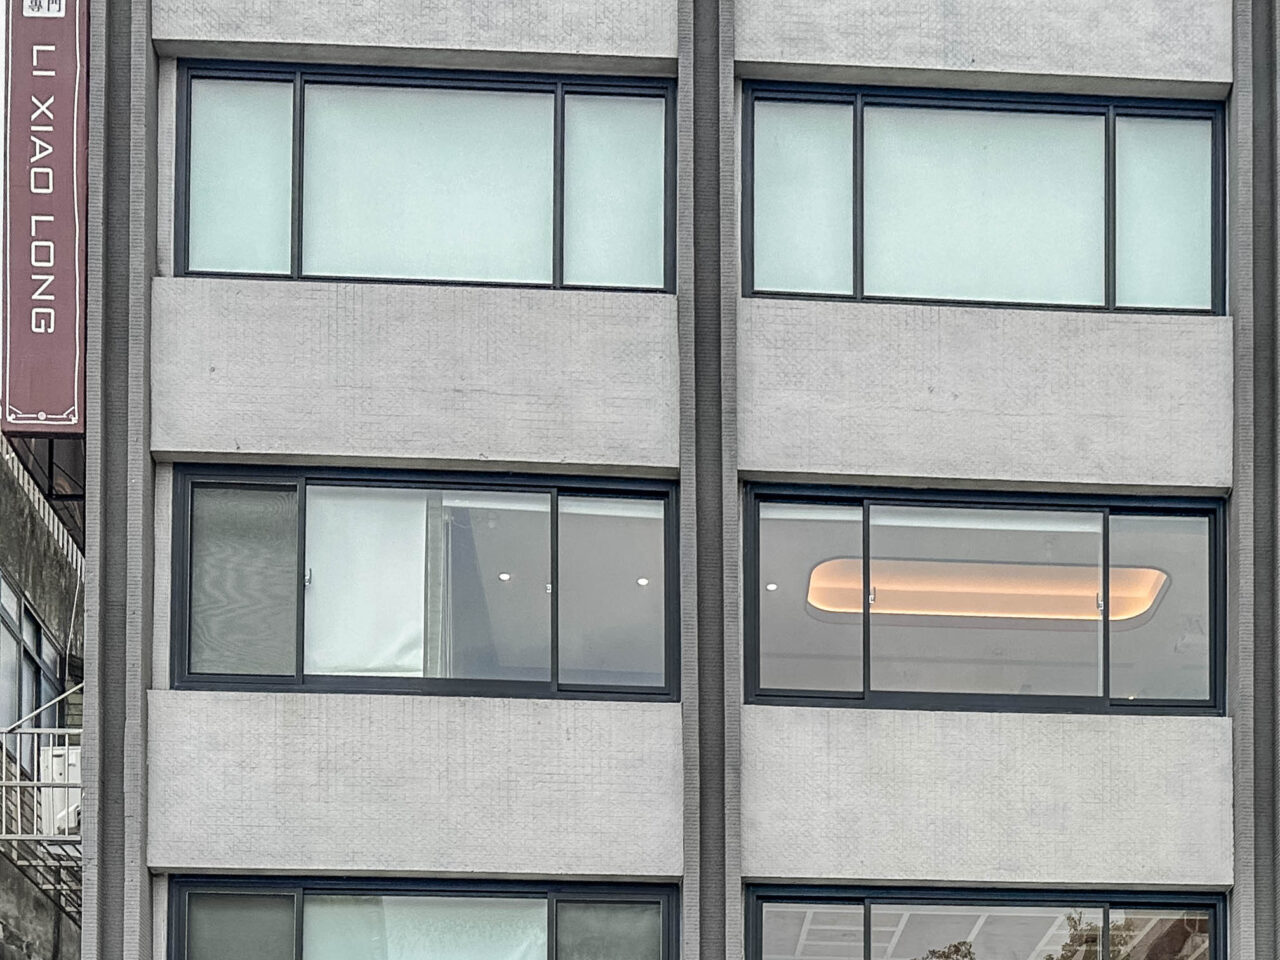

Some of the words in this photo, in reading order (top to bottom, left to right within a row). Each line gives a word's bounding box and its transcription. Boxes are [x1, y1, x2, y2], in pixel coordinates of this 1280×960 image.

[31, 44, 56, 77] LI
[30, 95, 55, 194] XIAO
[30, 215, 55, 334] LONG
